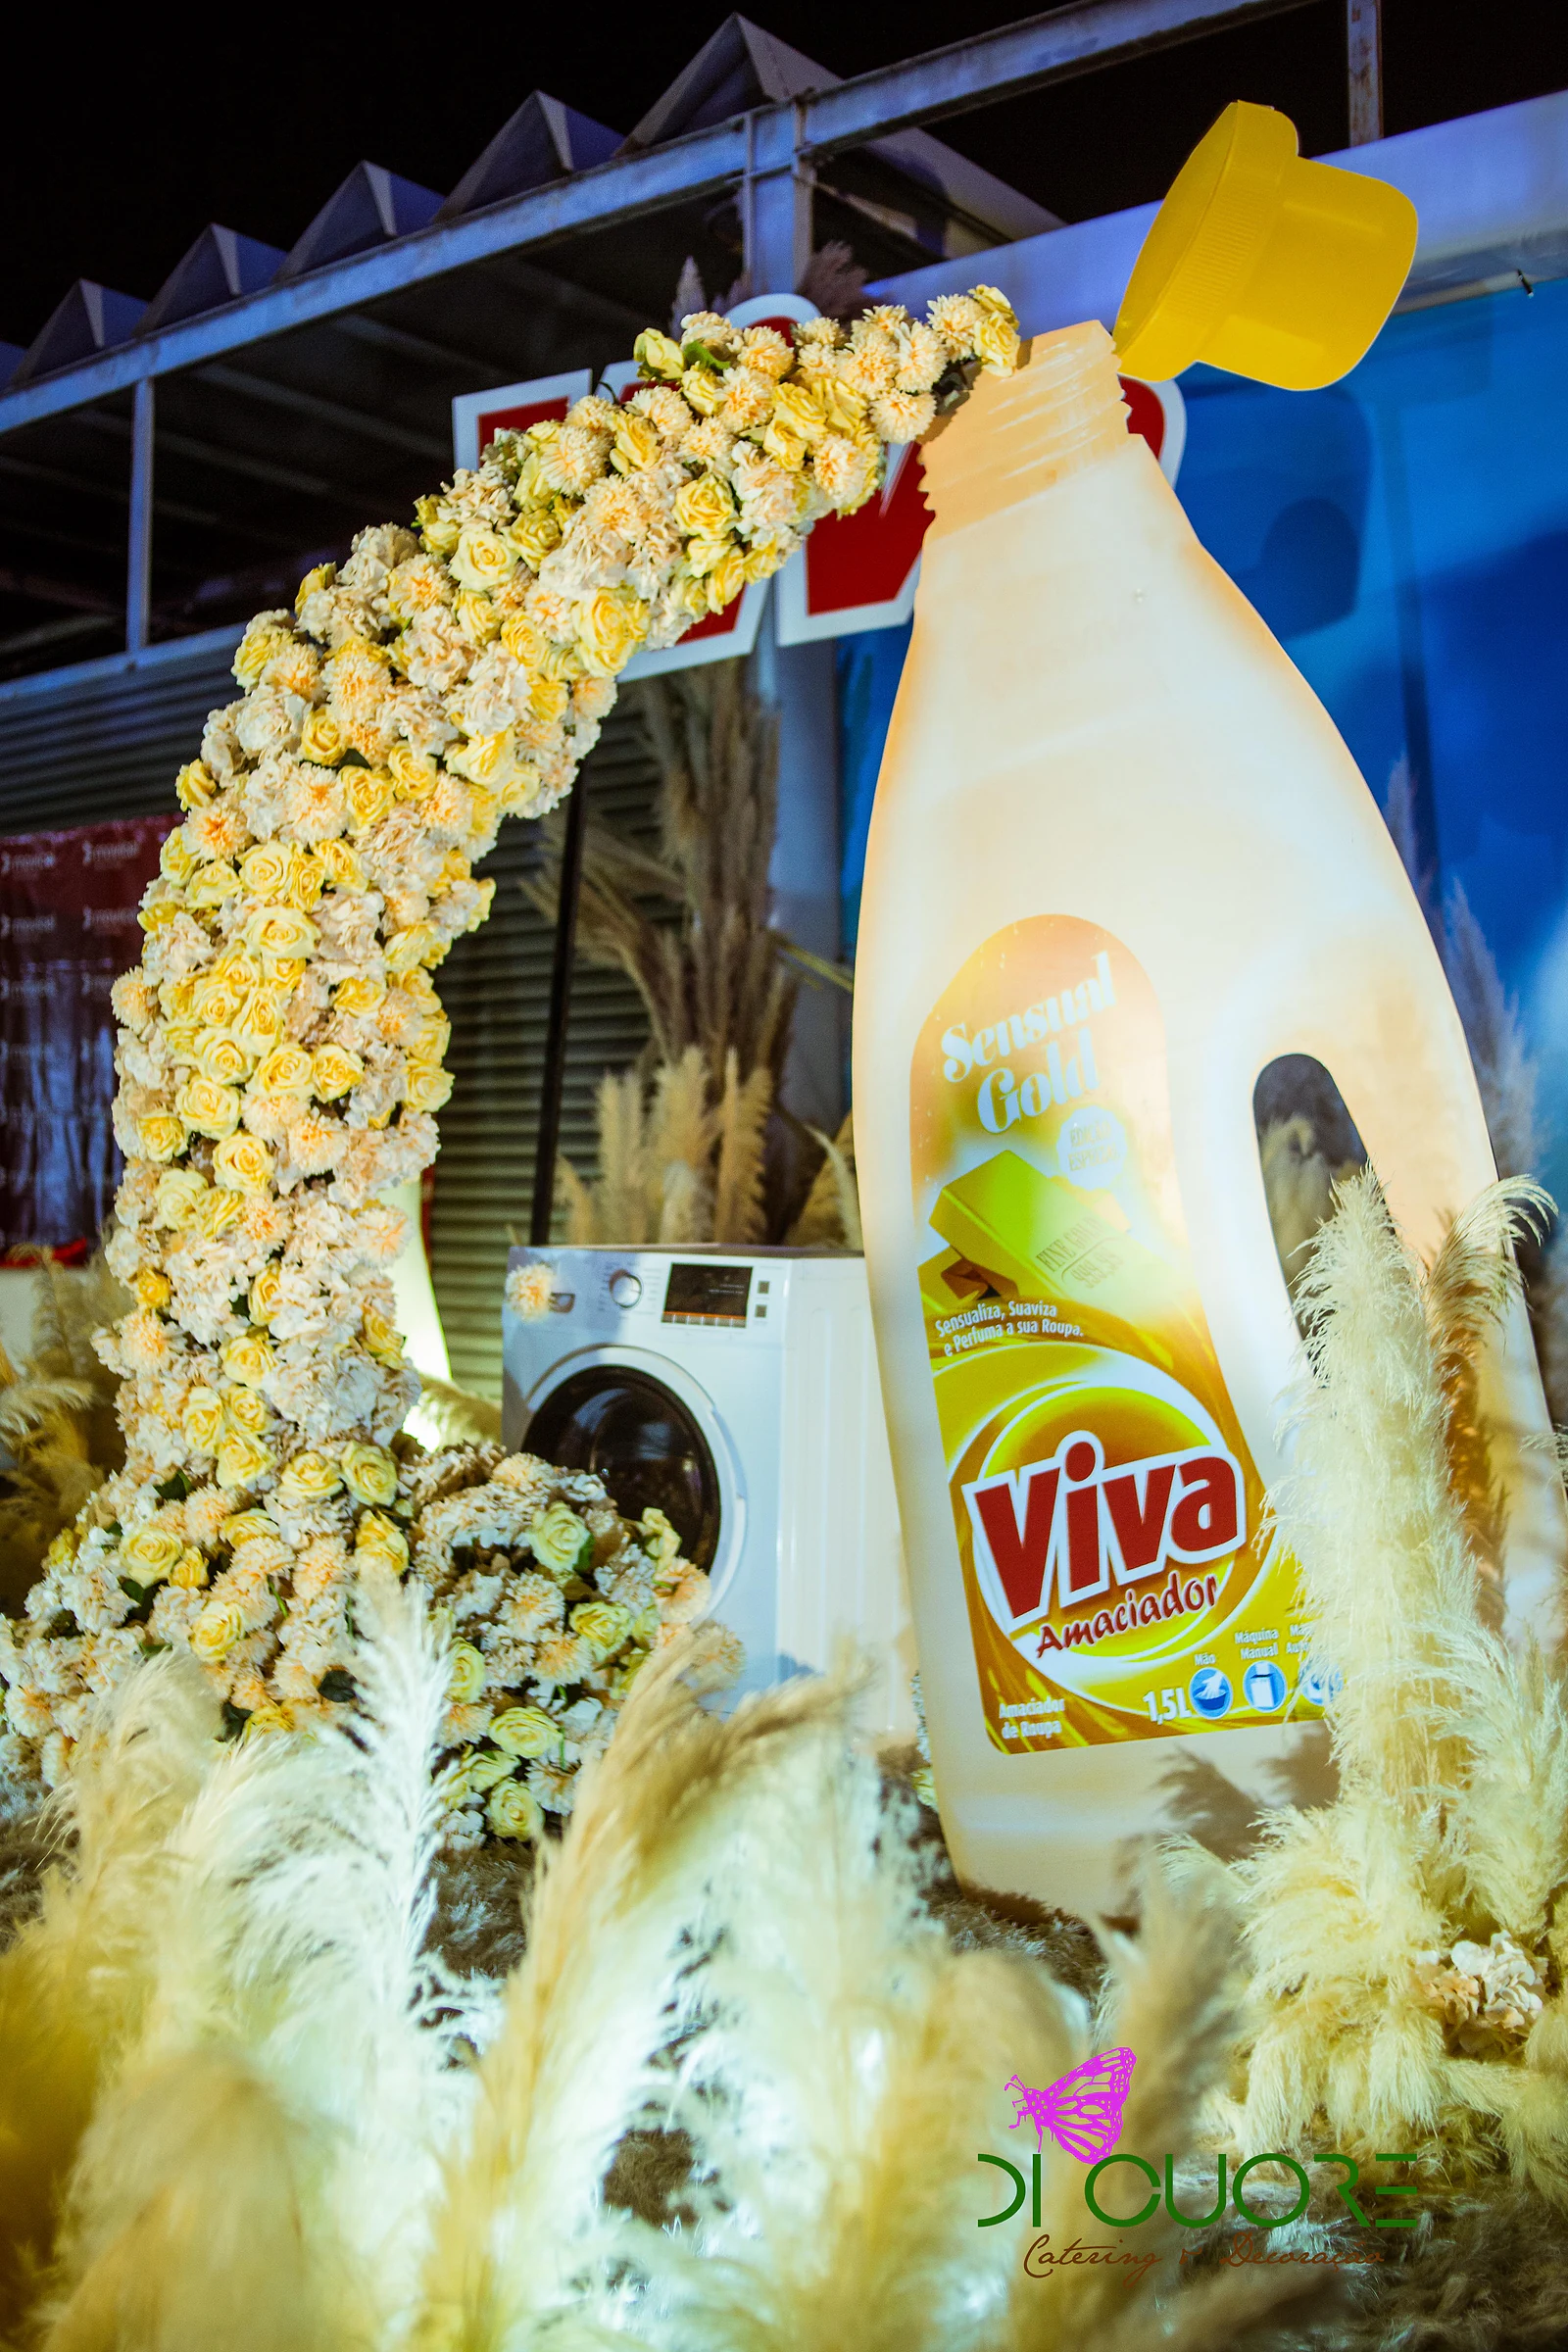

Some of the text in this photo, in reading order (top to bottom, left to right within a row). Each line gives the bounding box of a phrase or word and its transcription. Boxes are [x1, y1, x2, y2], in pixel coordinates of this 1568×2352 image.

[941, 951, 1116, 1083] Sensual
[977, 1027, 1100, 1134] Gold
[1036, 1217, 1104, 1273] FINE GOLD
[935, 1299, 1057, 1338] Sensualiza, Suaviza
[944, 1318, 1085, 1356] e Perfuma a sua Roupa.
[968, 1437, 1241, 1624] Viva
[1036, 1573, 1217, 1658] Amaciador
[1235, 1628, 1279, 1645] Máquina
[1240, 1642, 1278, 1660] Manual
[1194, 1652, 1216, 1666] Mão
[999, 1695, 1065, 1719] Amaciador
[1143, 1687, 1193, 1726] 1,5L
[1002, 1720, 1062, 1740] de Roupa
